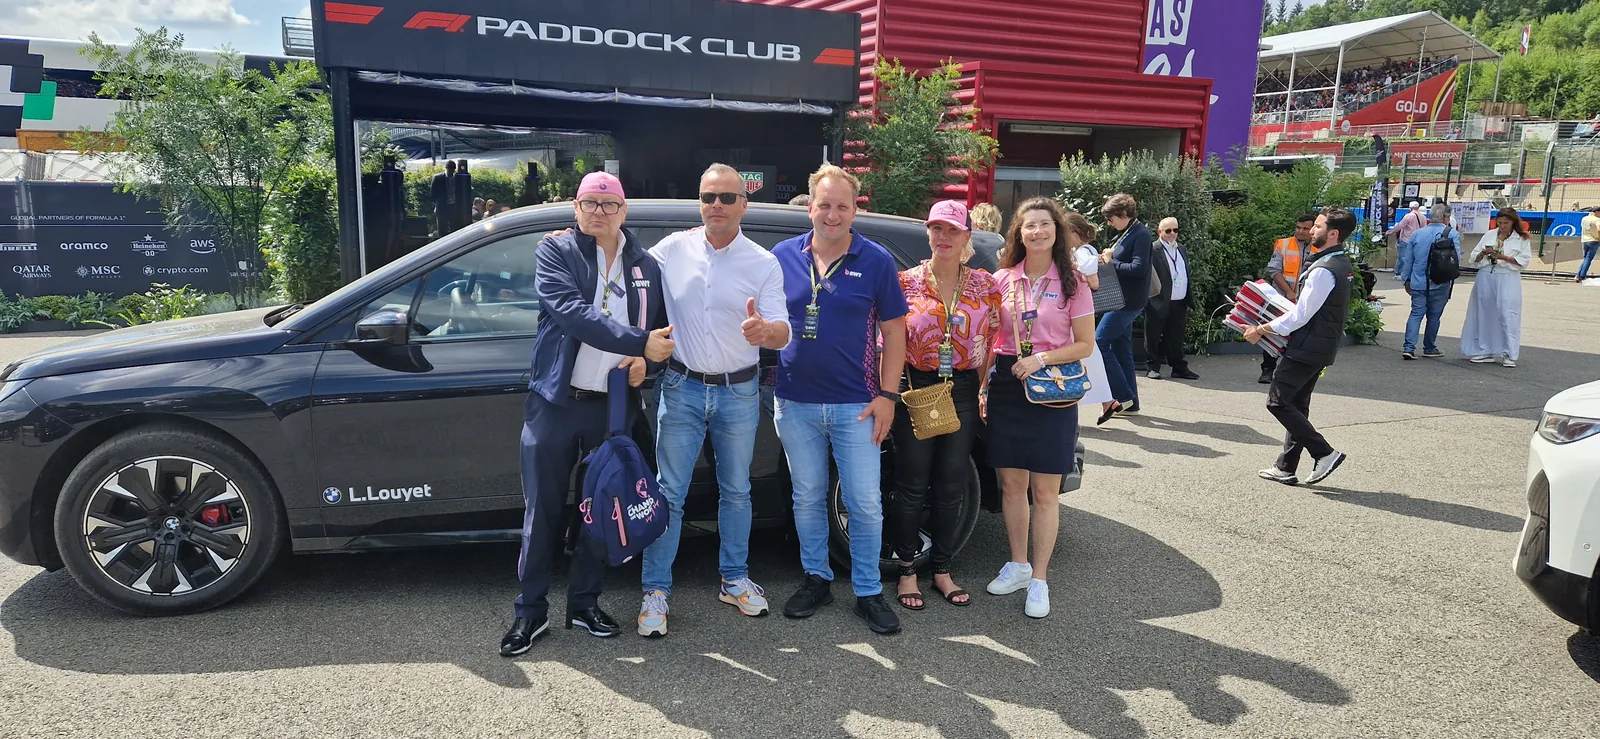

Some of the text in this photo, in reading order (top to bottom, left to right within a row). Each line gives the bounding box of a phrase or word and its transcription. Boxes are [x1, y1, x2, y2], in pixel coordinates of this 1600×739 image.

[477, 16, 692, 53] PADDOCK
[700, 38, 801, 62] CLUB
[1395, 100, 1428, 114] GOLD
[744, 181, 762, 191] EUER
[60, 242, 108, 250] aramco
[190, 239, 215, 247] aws
[12, 265, 51, 275] QATAR
[91, 265, 121, 274] MSC
[157, 265, 208, 276] crypto.com
[349, 484, 432, 502] L.Louyet
